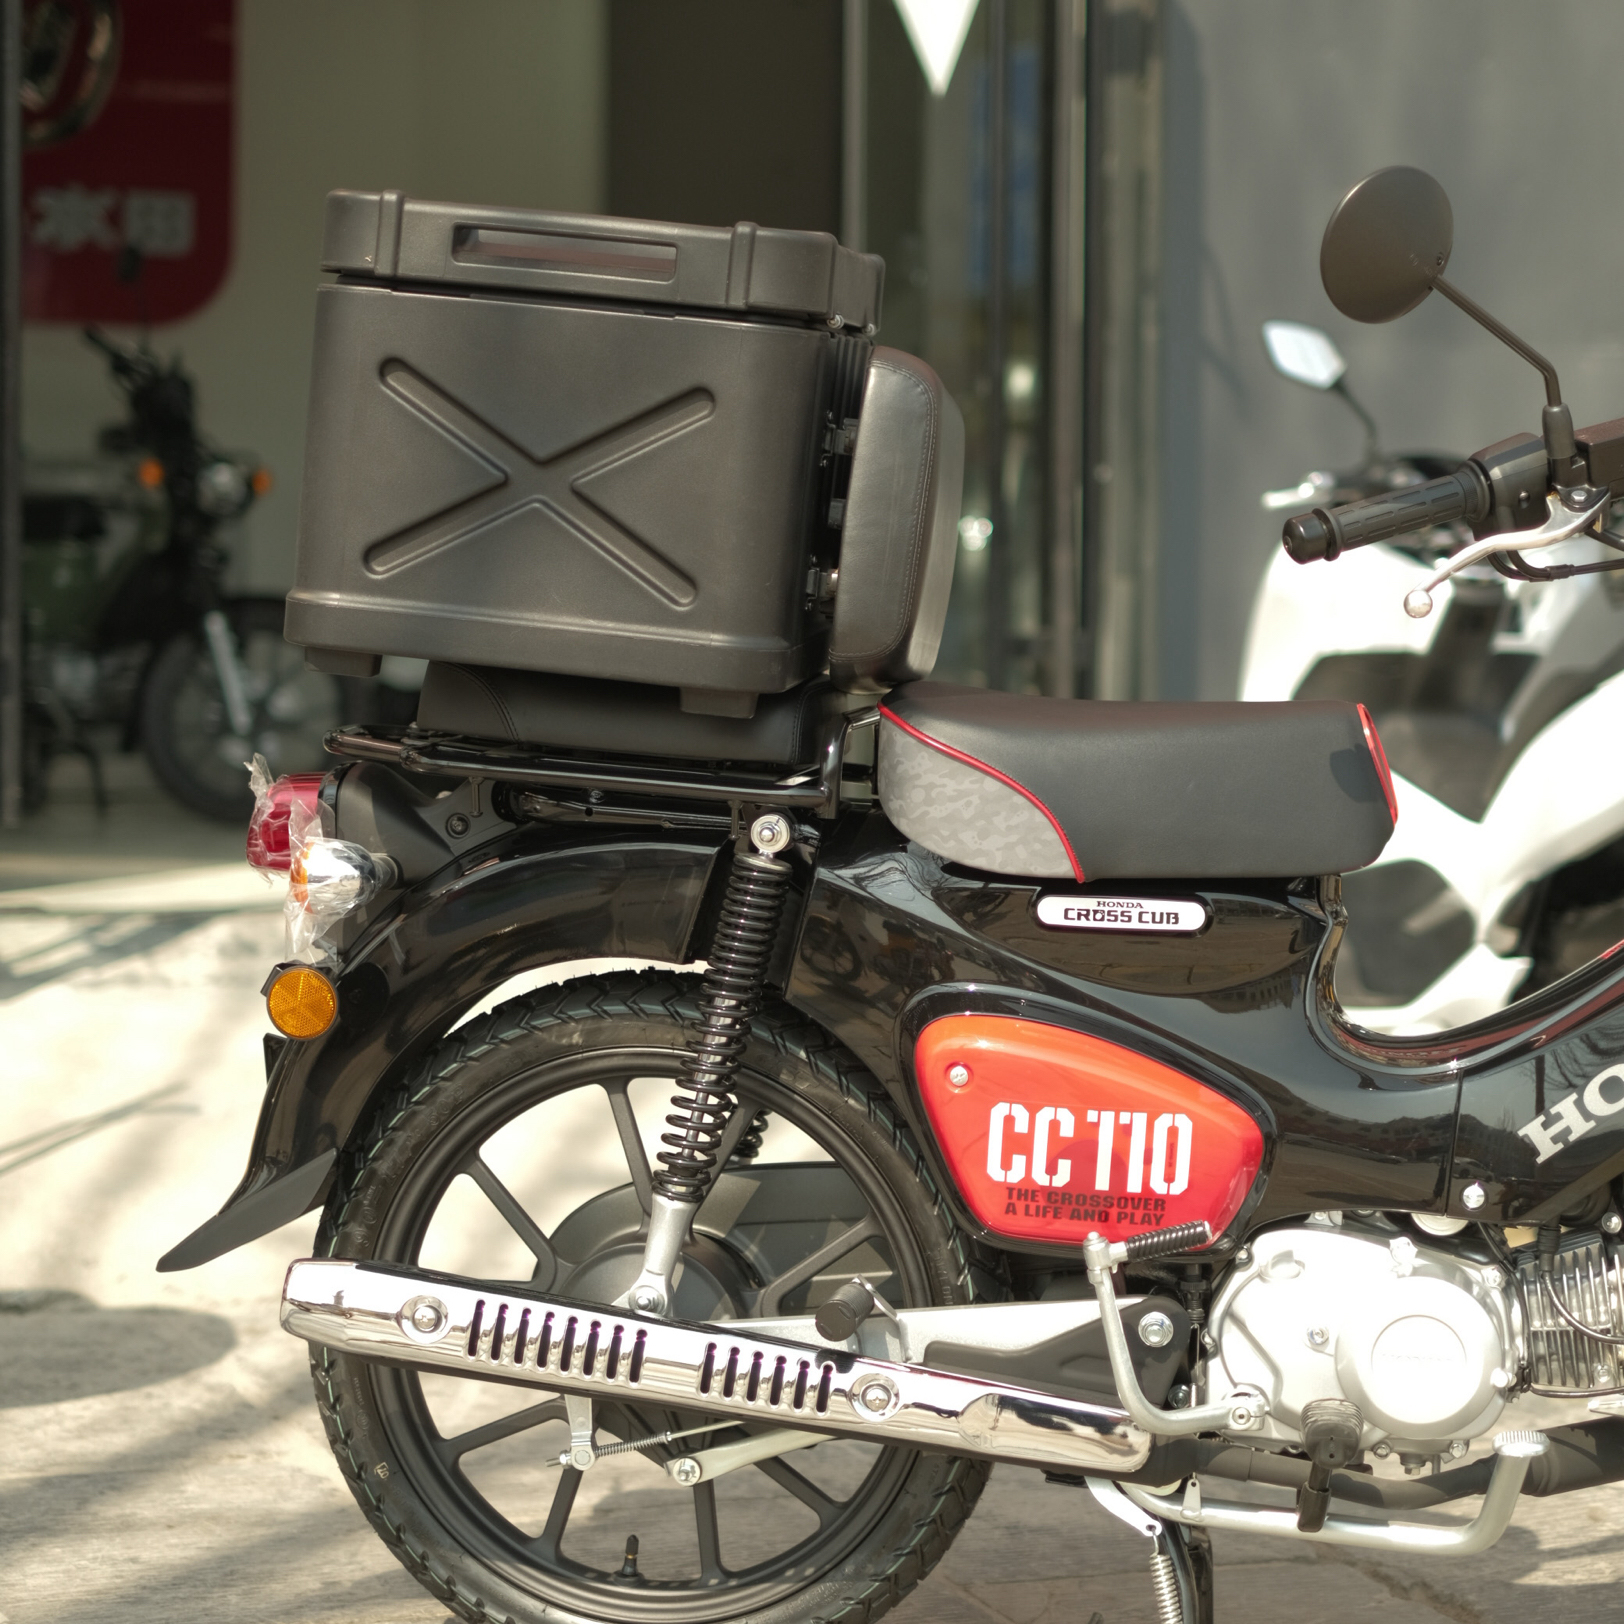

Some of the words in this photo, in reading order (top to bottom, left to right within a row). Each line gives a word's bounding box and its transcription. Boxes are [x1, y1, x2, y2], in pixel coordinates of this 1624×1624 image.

[1096, 900, 1143, 909] HONDA
[1063, 908, 1132, 923] CROSS
[1138, 911, 1180, 925] CUB
[1006, 1186, 1046, 1202] THE
[1047, 1190, 1167, 1212] CROSSOVER
[1004, 1202, 1018, 1216] A
[1024, 1204, 1063, 1220] LIFE
[1069, 1206, 1110, 1223] AND
[1116, 1209, 1165, 1227] PLAY
